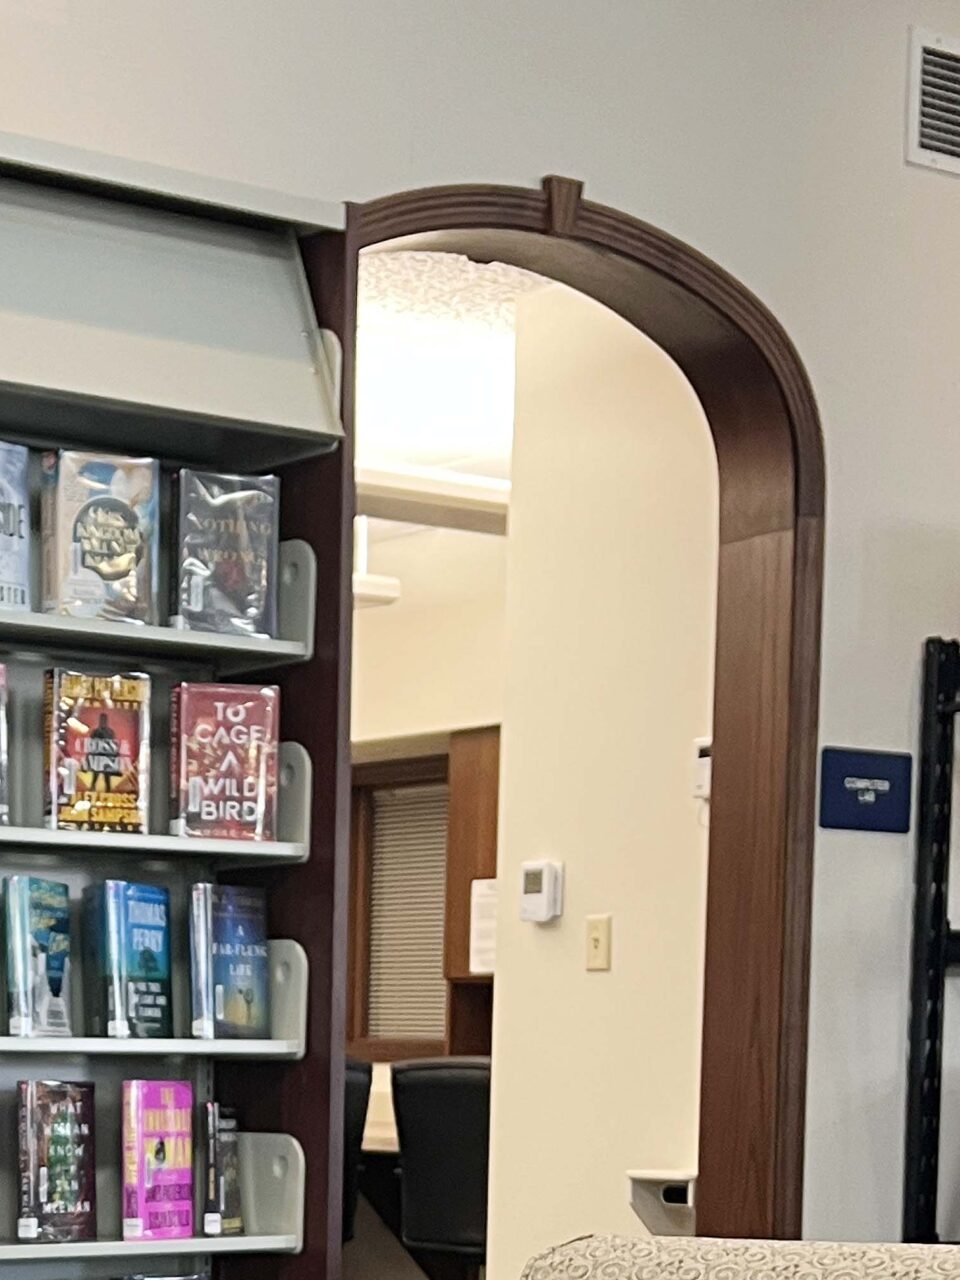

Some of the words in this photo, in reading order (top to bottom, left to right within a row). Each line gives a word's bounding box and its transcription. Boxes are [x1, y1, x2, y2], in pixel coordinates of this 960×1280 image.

[213, 701, 247, 723] TO
[194, 723, 263, 747] CAGE
[219, 749, 240, 774] A
[199, 776, 258, 798] WILD
[201, 800, 257, 821] BIRD
